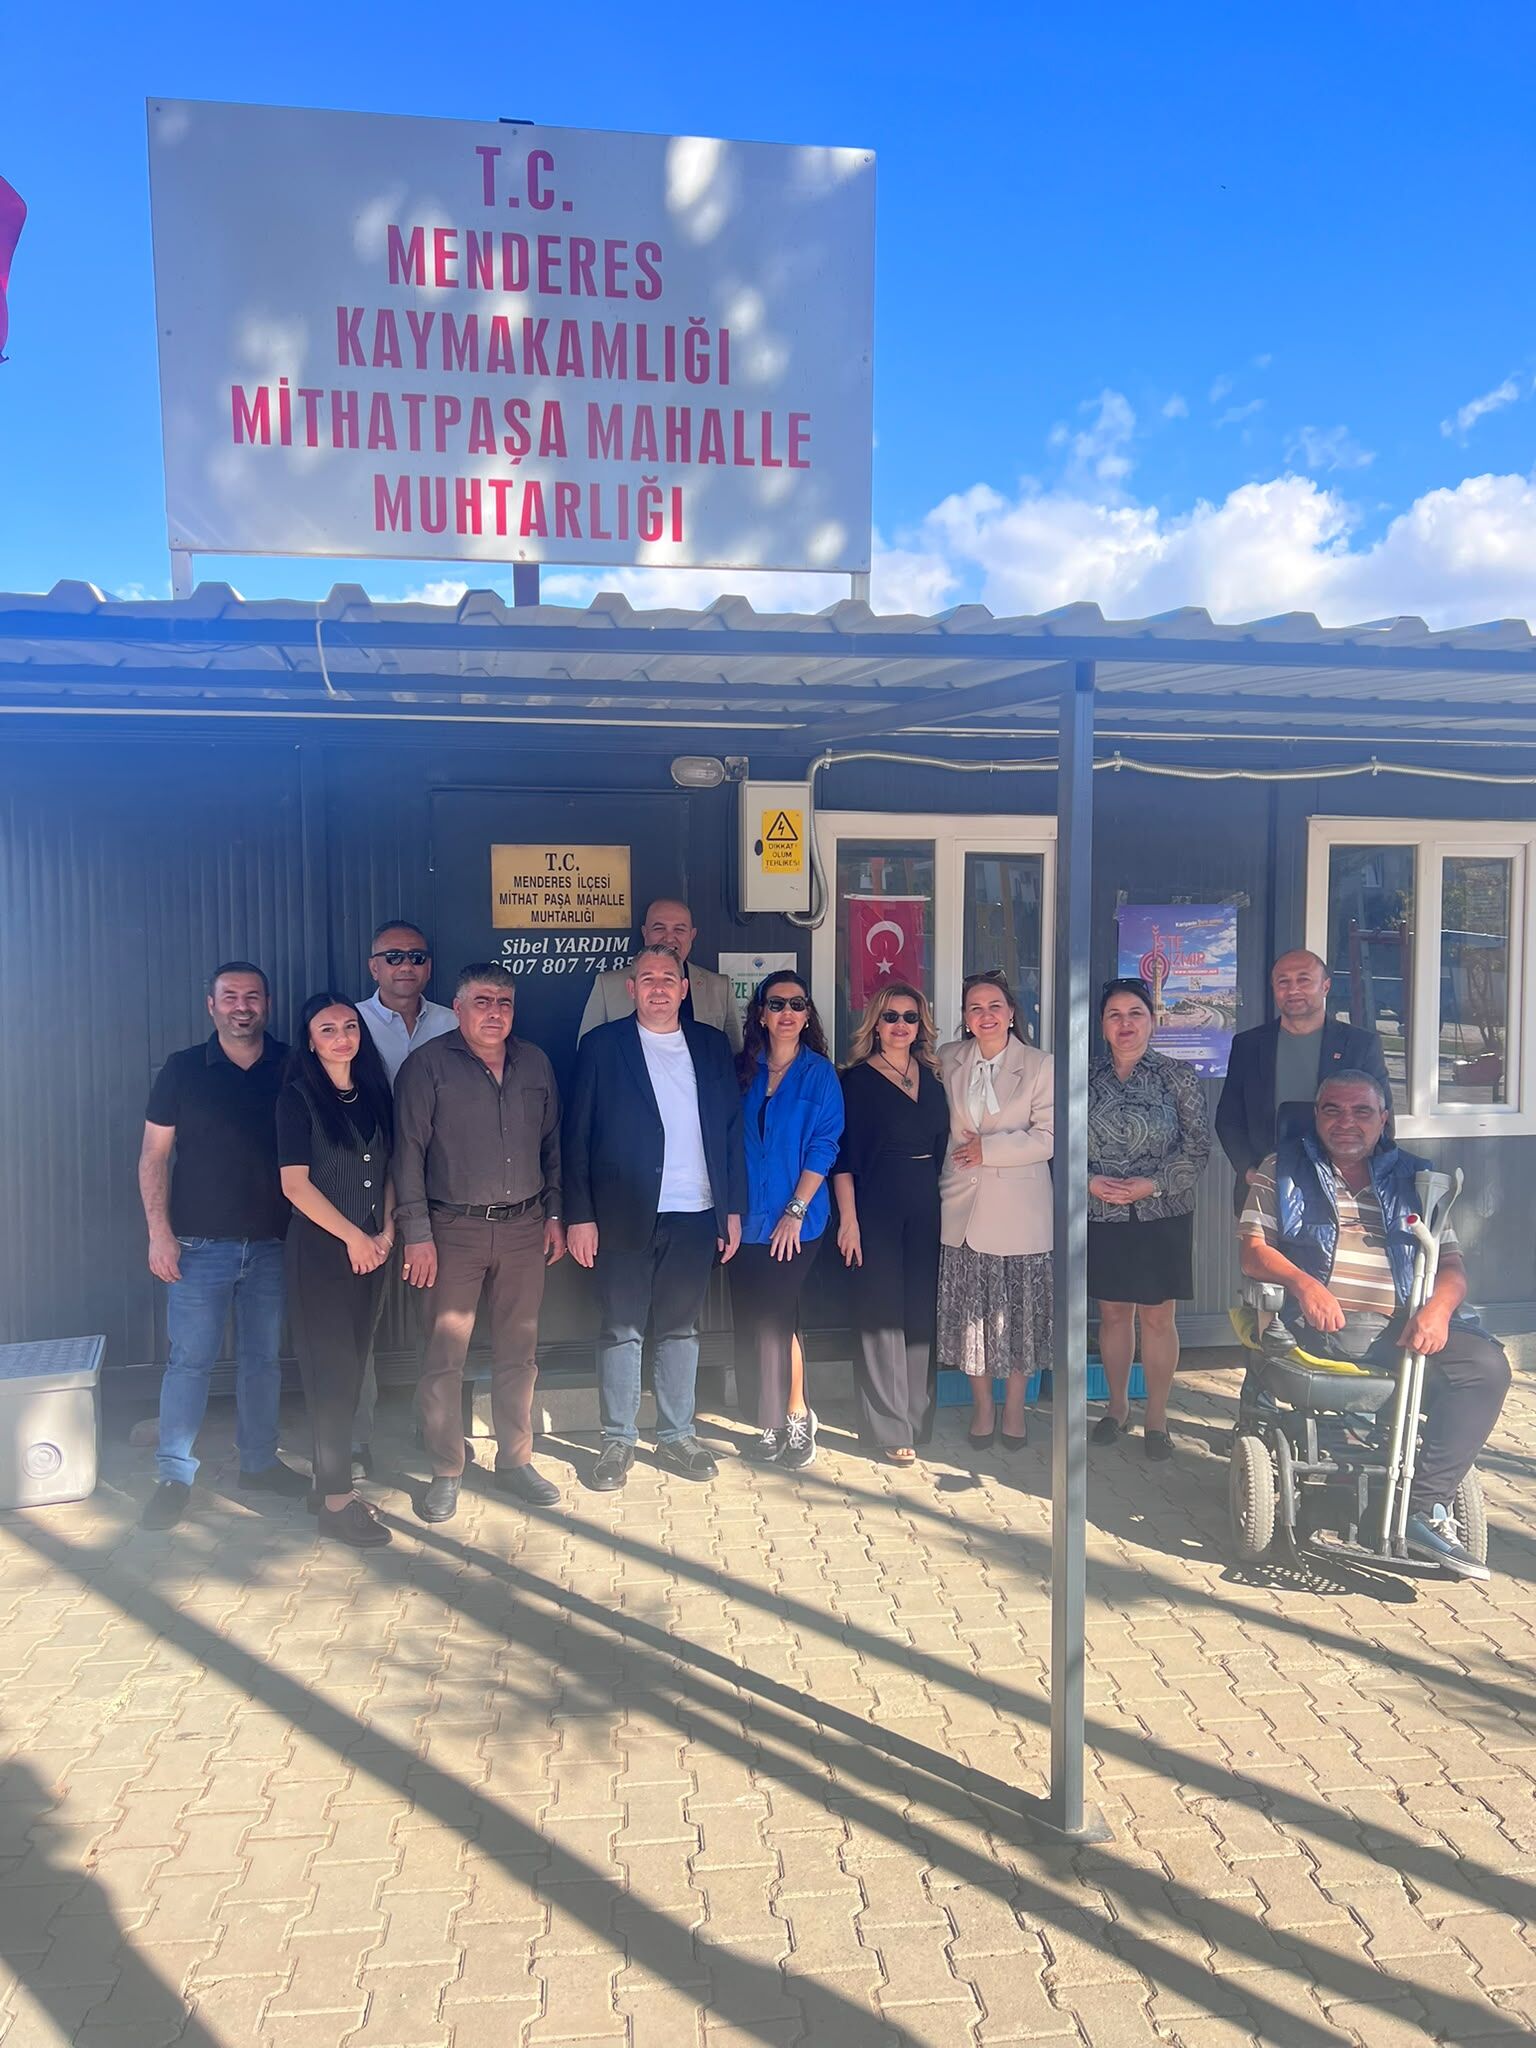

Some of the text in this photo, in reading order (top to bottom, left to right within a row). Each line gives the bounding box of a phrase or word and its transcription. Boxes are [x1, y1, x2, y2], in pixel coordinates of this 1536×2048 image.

[475, 145, 574, 212] T.C.
[387, 224, 664, 300] MENDERES
[336, 306, 731, 386] KAYMAKAMLIĞI
[231, 376, 812, 468] MİTHATPAŞA MAHALLE
[374, 474, 683, 543] MUHTARLIĞI
[545, 853, 580, 872] T.C.
[513, 873, 611, 892] MENDERES İLÇESİ
[500, 889, 625, 909] MİTHAT PAŞA MAHALLE
[531, 907, 595, 923] MUHTARLIĞI
[501, 936, 630, 955] Sibel YARDIM
[541, 957, 579, 975] 807
[584, 956, 608, 973] 74
